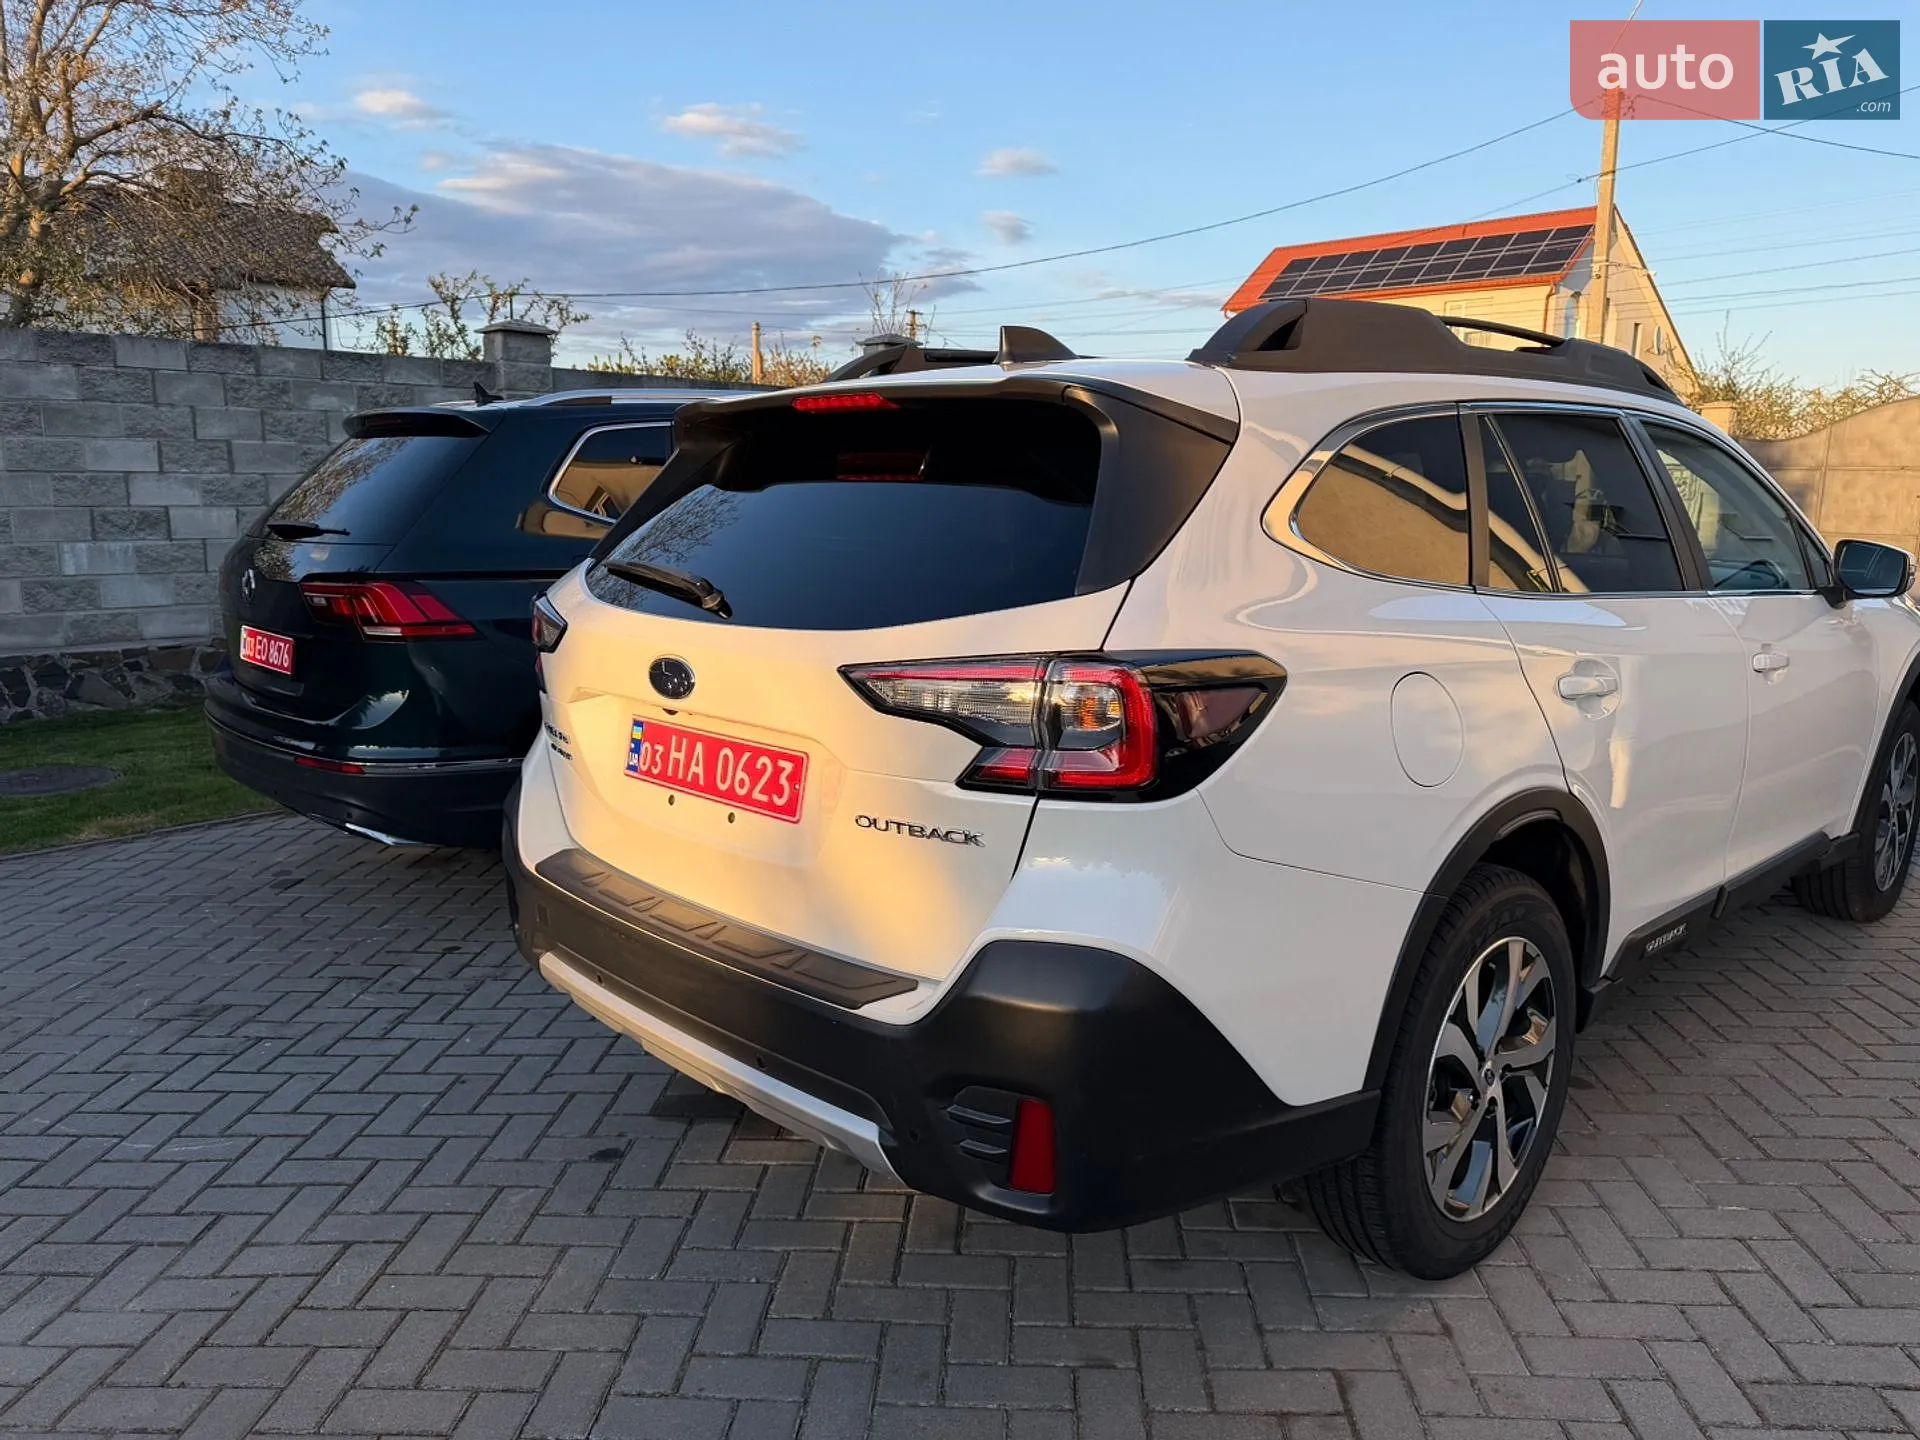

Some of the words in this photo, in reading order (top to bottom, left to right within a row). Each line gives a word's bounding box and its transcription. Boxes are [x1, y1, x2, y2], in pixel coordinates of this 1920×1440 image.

[640, 741, 664, 774] 03
[667, 735, 704, 785] HA
[715, 747, 795, 806] 0623
[854, 814, 986, 847] OUTBACK
